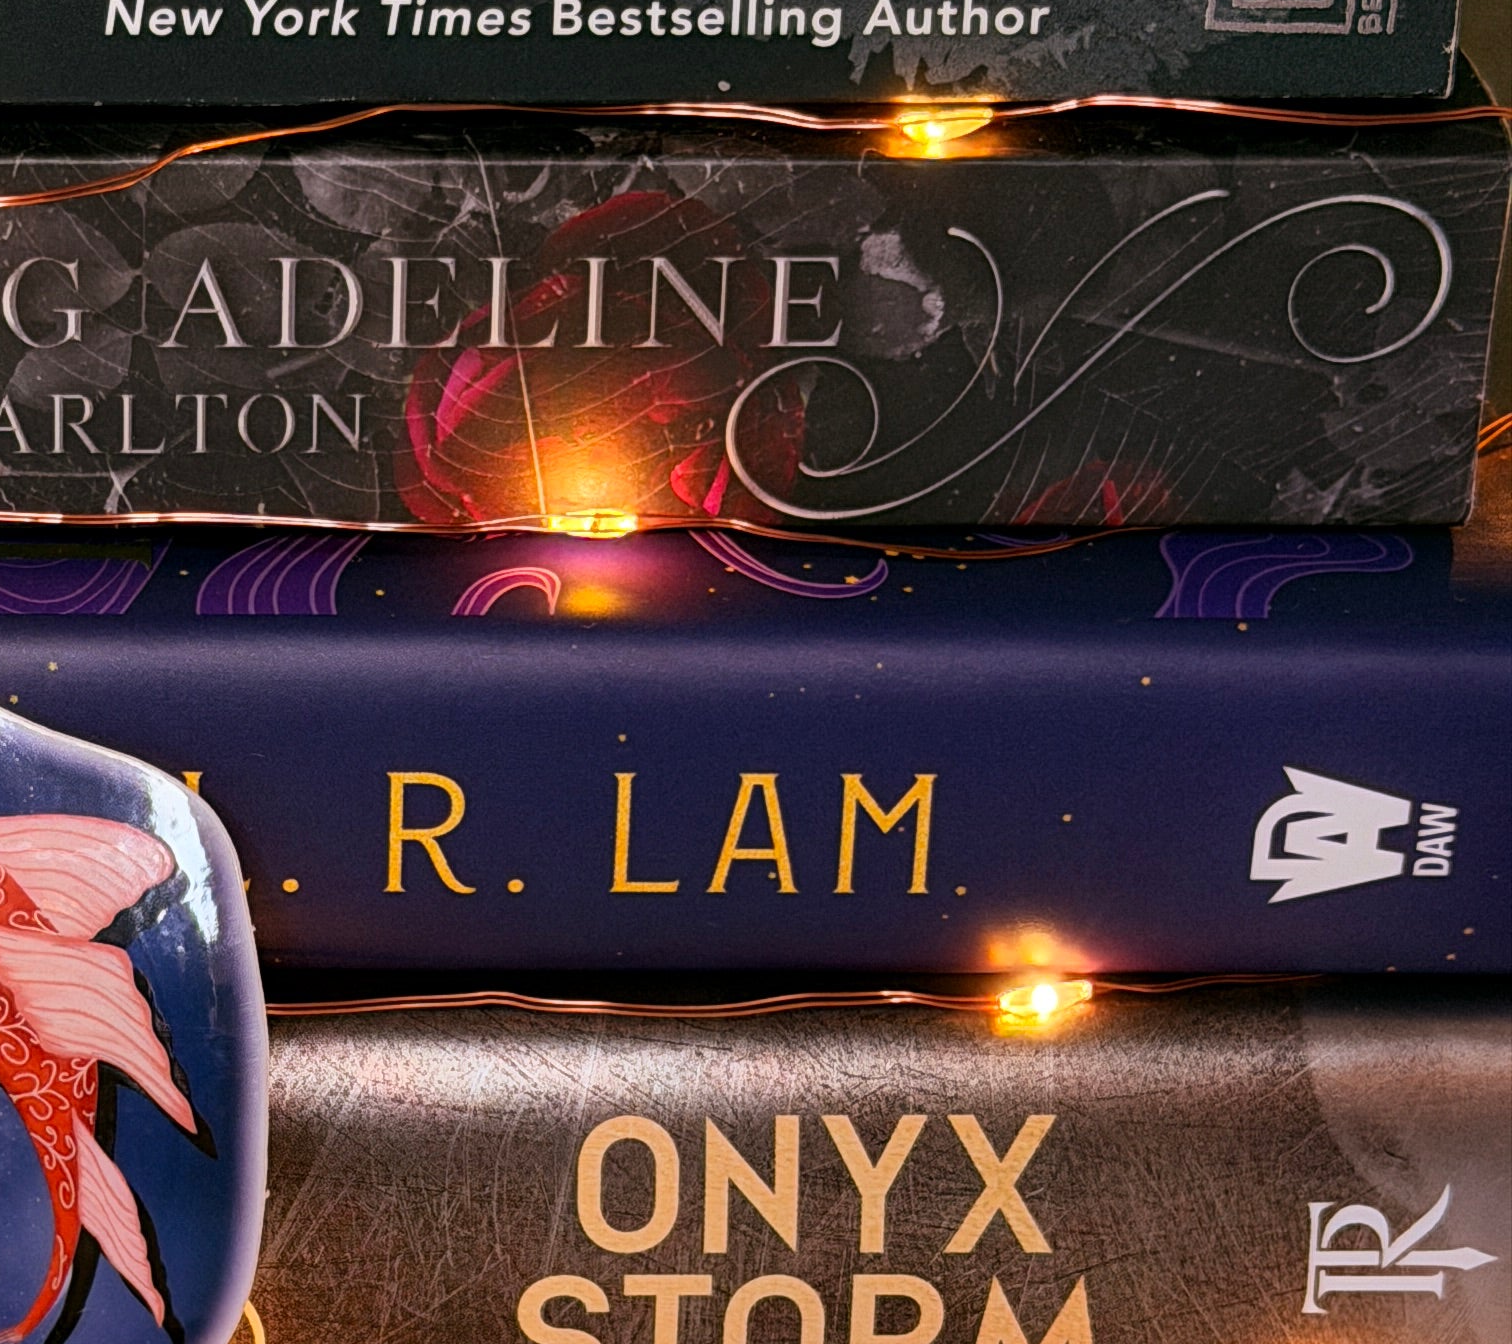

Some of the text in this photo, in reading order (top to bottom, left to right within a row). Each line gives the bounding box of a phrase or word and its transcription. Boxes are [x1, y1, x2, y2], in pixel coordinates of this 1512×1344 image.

[158, 256, 844, 349] ADELINE
[382, 771, 525, 894] R.
[609, 772, 938, 893] LAM
[1412, 802, 1459, 877] DAW
[576, 1114, 1057, 1254] ONYX
